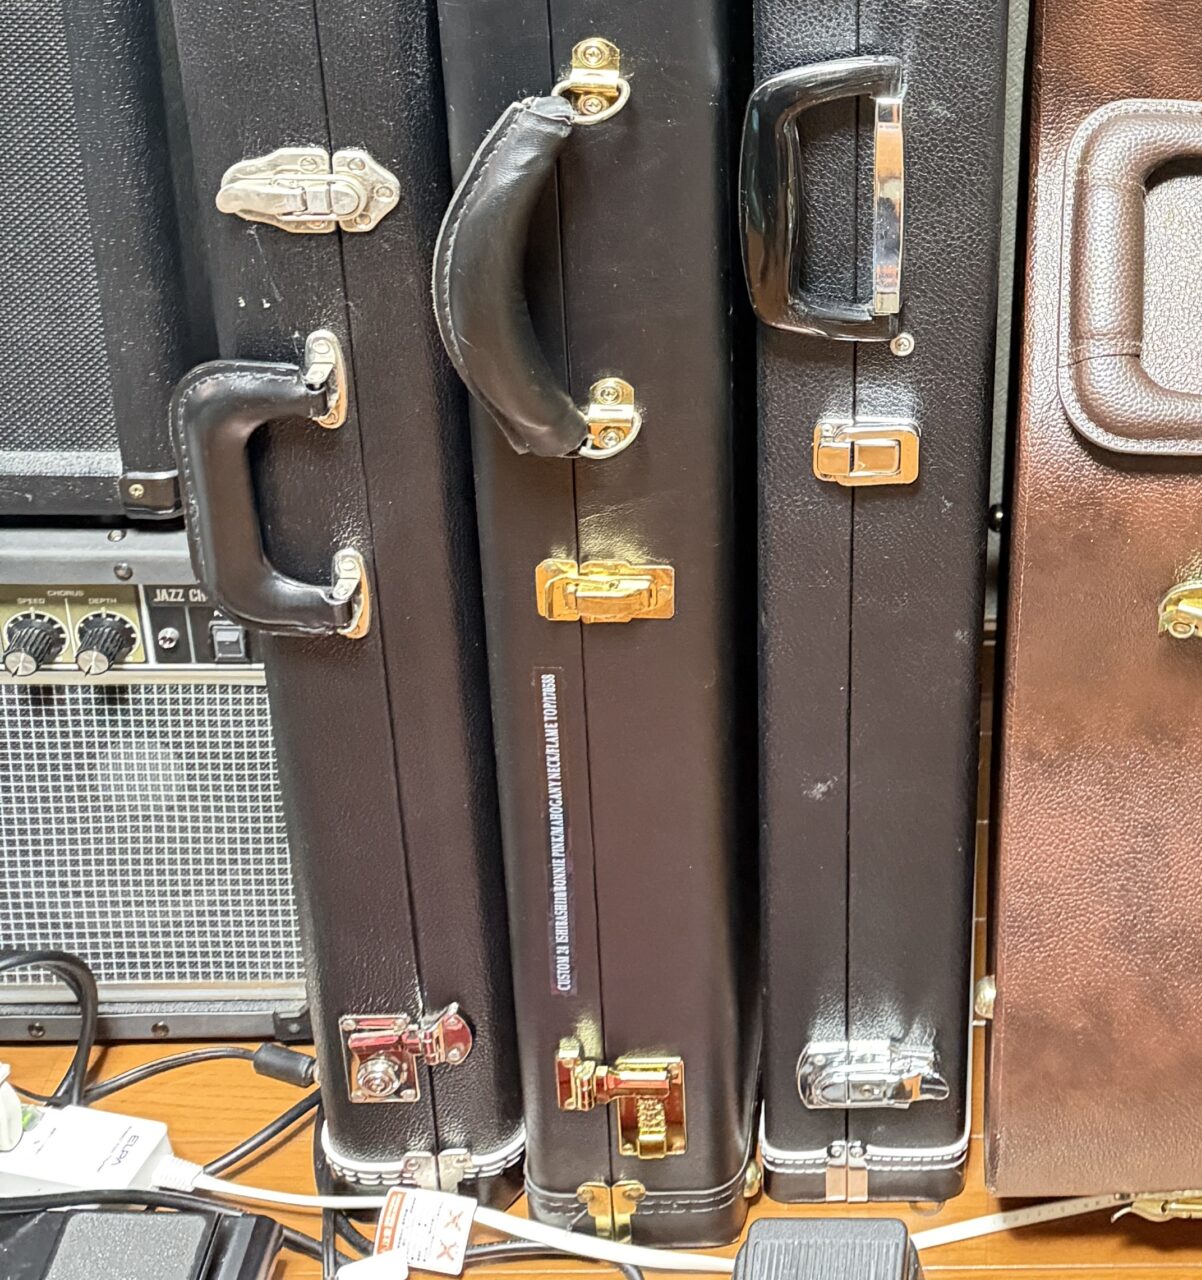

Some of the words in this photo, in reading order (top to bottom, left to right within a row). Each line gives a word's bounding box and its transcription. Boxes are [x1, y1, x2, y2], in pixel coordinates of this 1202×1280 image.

[46, 589, 84, 597] CHORUS
[153, 588, 185, 603] JAZZ
[16, 597, 46, 605] SPEED
[88, 597, 118, 605] DEPTH
[544, 722, 562, 780] NECK/FLAME
[548, 780, 566, 857] PINK/MAHOGANY
[555, 945, 570, 955] 24
[555, 955, 571, 991] CUSTOM
